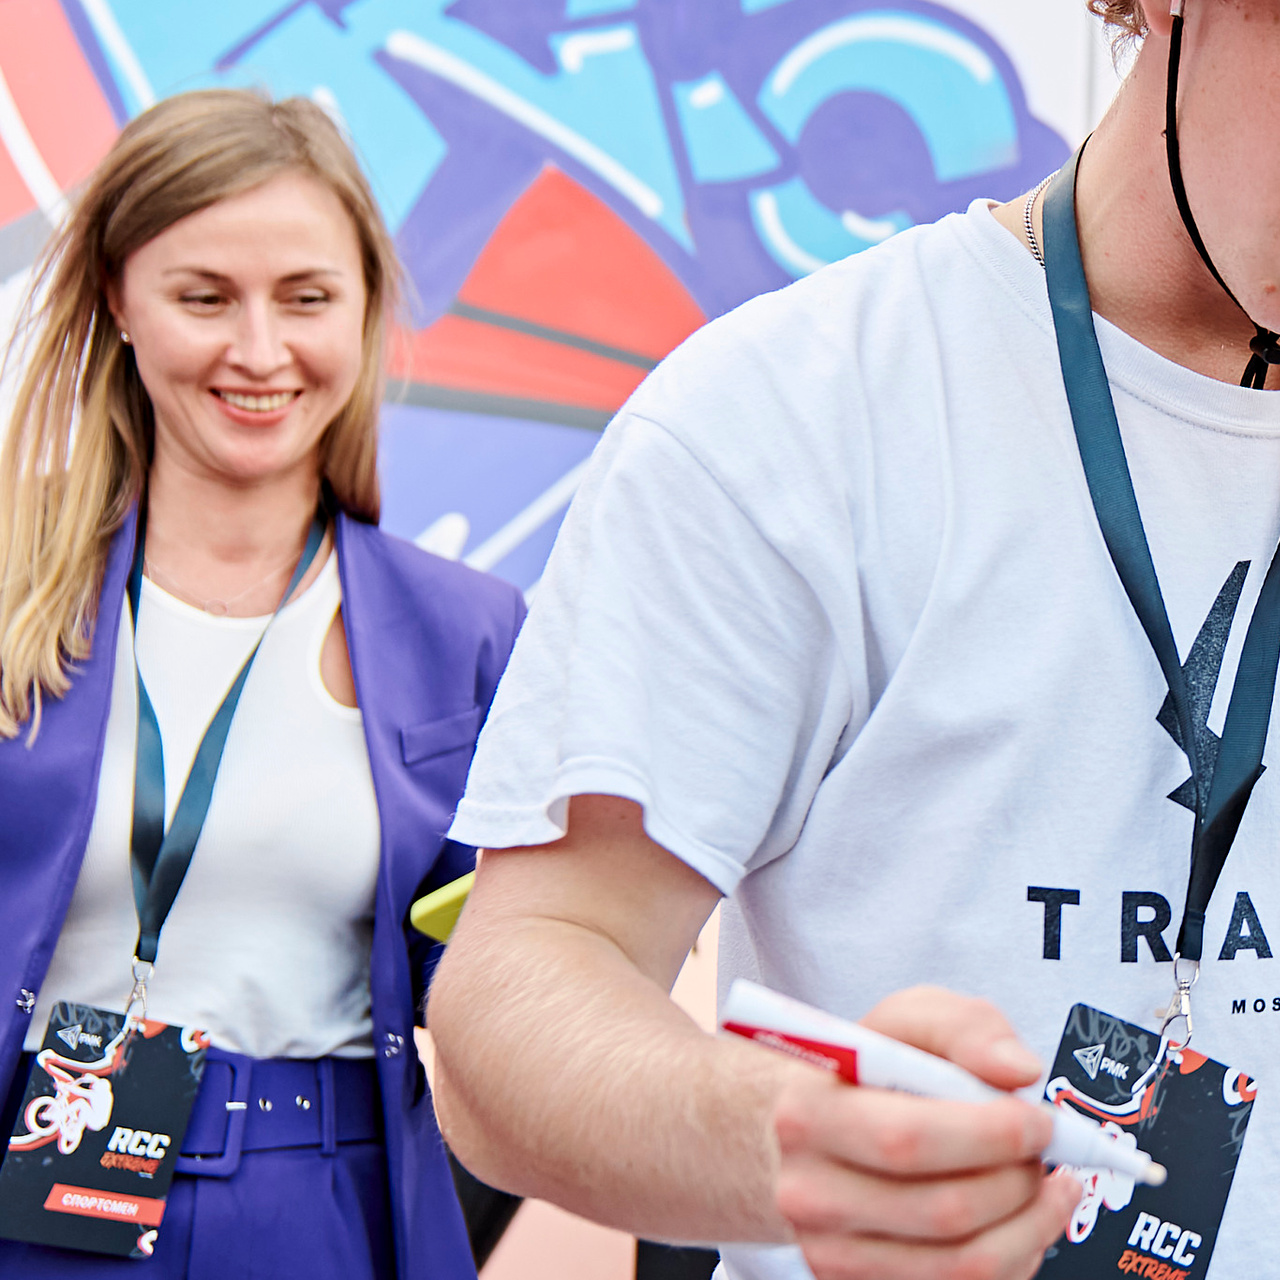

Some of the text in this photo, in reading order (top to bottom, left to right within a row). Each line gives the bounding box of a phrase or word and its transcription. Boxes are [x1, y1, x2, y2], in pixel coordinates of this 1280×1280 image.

[107, 1126, 171, 1159] RCC
[61, 1192, 139, 1217] СПОРТСМЕН
[1127, 1210, 1202, 1268] RCC
